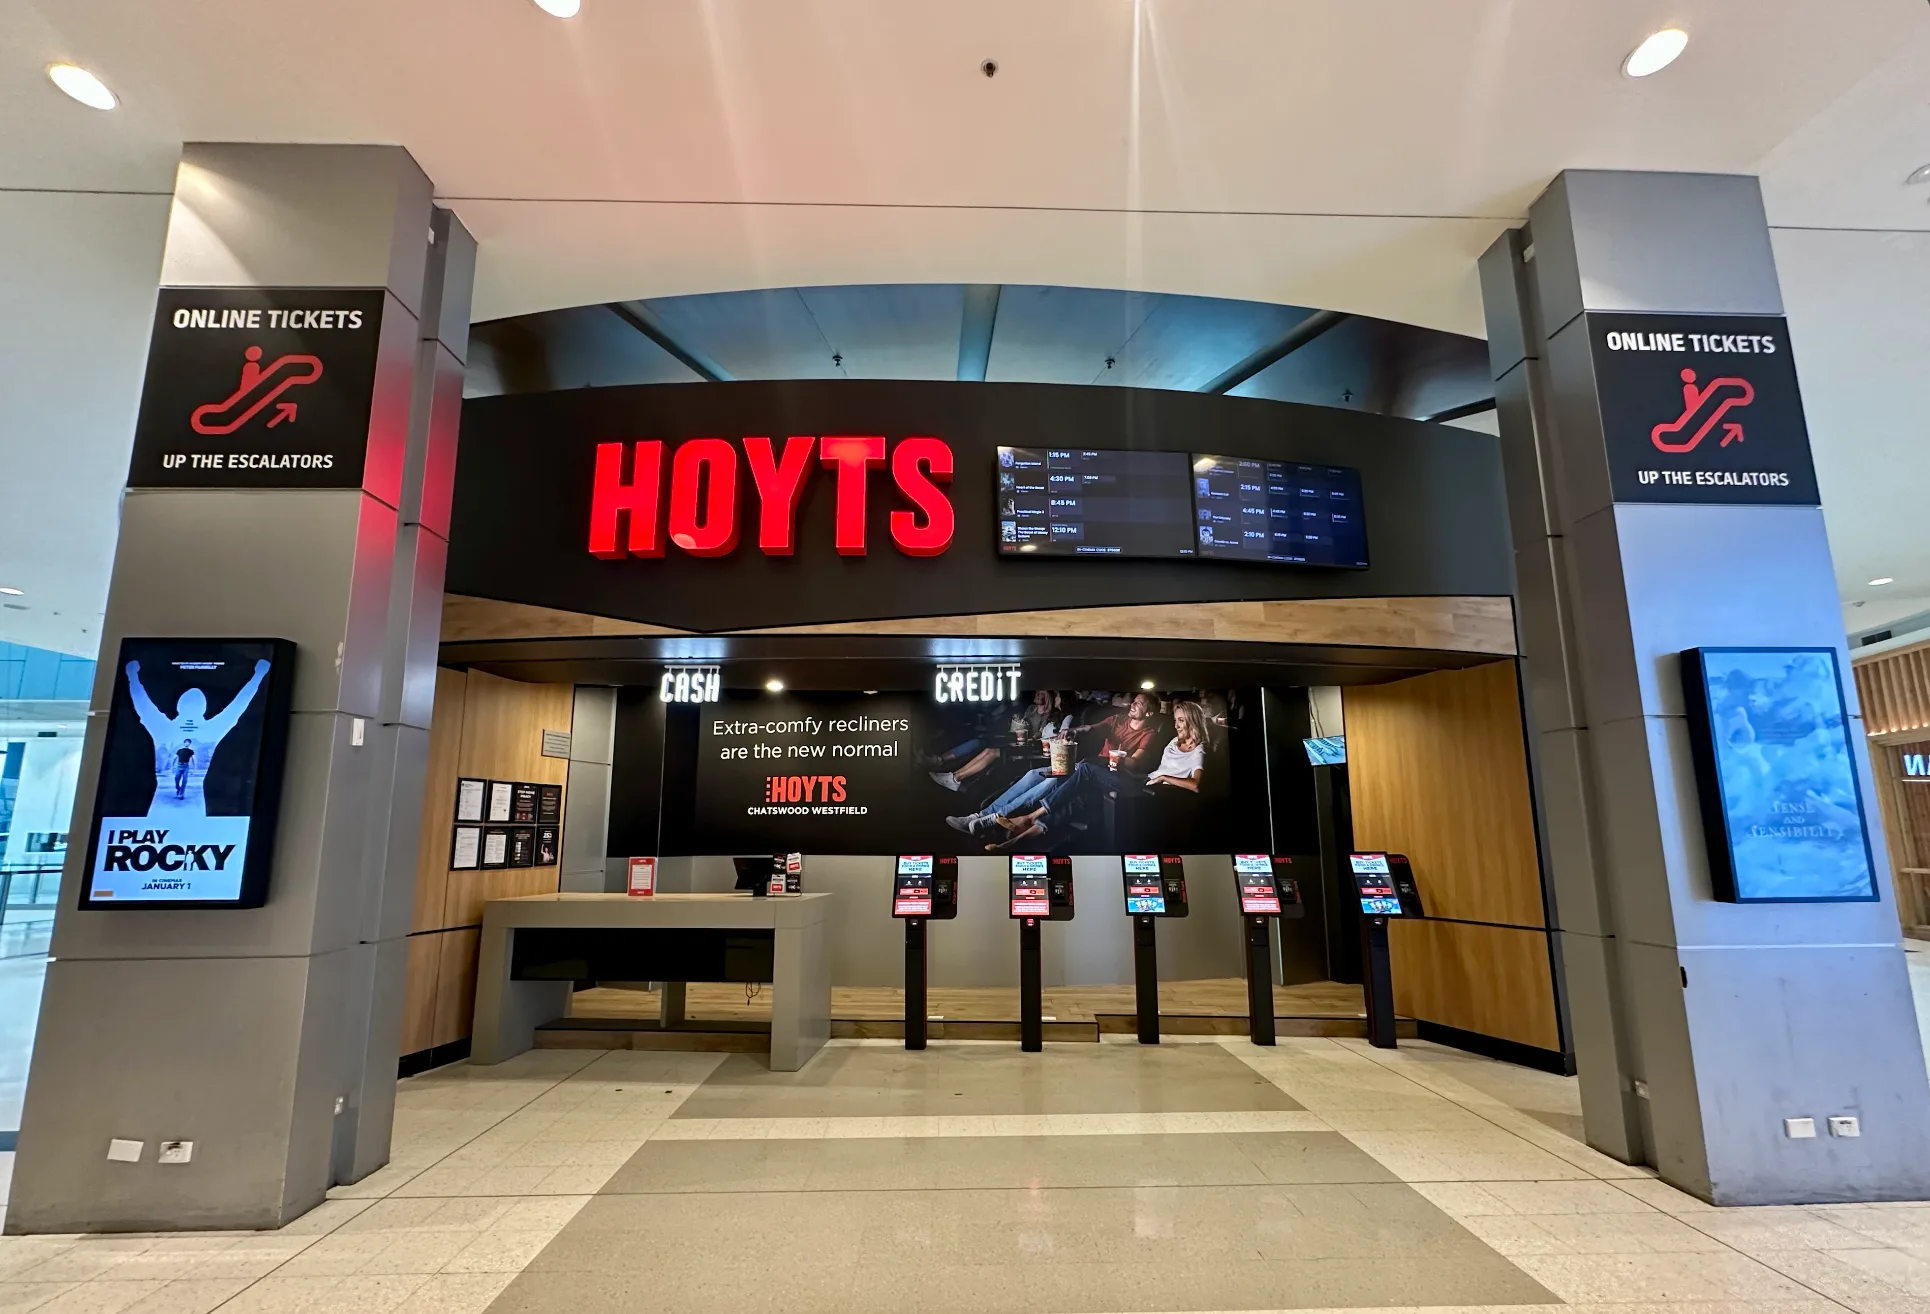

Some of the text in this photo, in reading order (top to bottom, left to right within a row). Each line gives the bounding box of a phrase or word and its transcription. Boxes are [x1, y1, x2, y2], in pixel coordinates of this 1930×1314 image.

[173, 308, 363, 329] ONLINE TICKETS
[1606, 332, 1776, 353] ONLINE TICKETS
[163, 454, 333, 469] UP THE ESCALATORS
[1638, 470, 1789, 486] UP THE ESCALATORS
[588, 436, 954, 559] HOYTS
[660, 671, 721, 703] CASH
[935, 670, 1021, 703] CREDIT
[713, 715, 909, 738] Extra-comfy recliners
[720, 741, 898, 760] are the new normal
[1903, 754, 1930, 776] W
[771, 776, 847, 803] HOYTS
[747, 806, 867, 815] CHATSWOOD WESTFIELD
[108, 830, 169, 844] I PLAY
[103, 844, 237, 871] ROCKY
